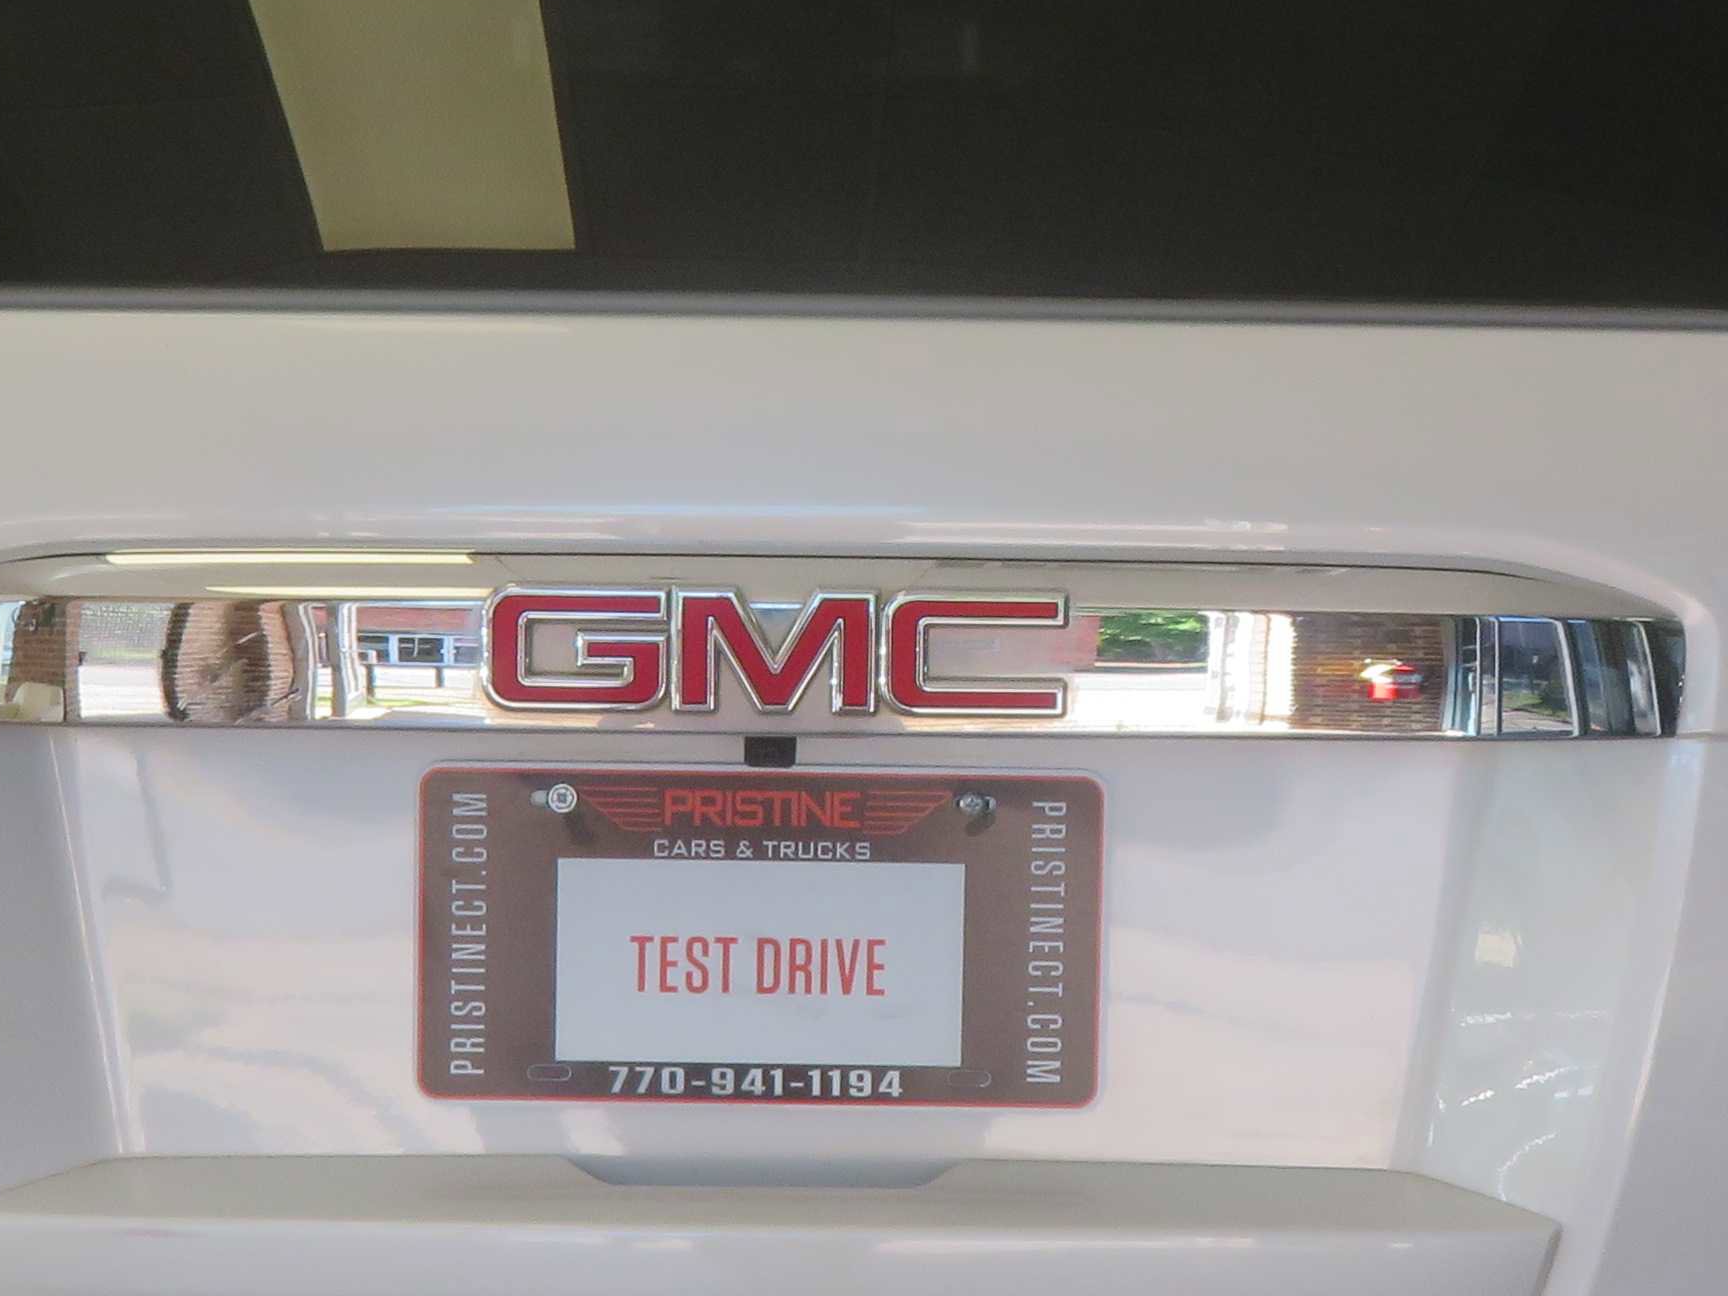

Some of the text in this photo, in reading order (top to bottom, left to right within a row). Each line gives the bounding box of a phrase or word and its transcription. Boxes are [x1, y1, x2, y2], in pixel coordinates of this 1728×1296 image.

[480, 583, 1069, 717] GMC
[663, 789, 863, 829] PRISTINE
[653, 839, 871, 860] CARS & TRUCKS
[449, 791, 489, 1075] PRISTINECT.COM
[1025, 800, 1067, 1086] PRISTINECT.COM
[630, 935, 886, 997] TEST DRIVE
[608, 1066, 903, 1098] 770-941-1194
